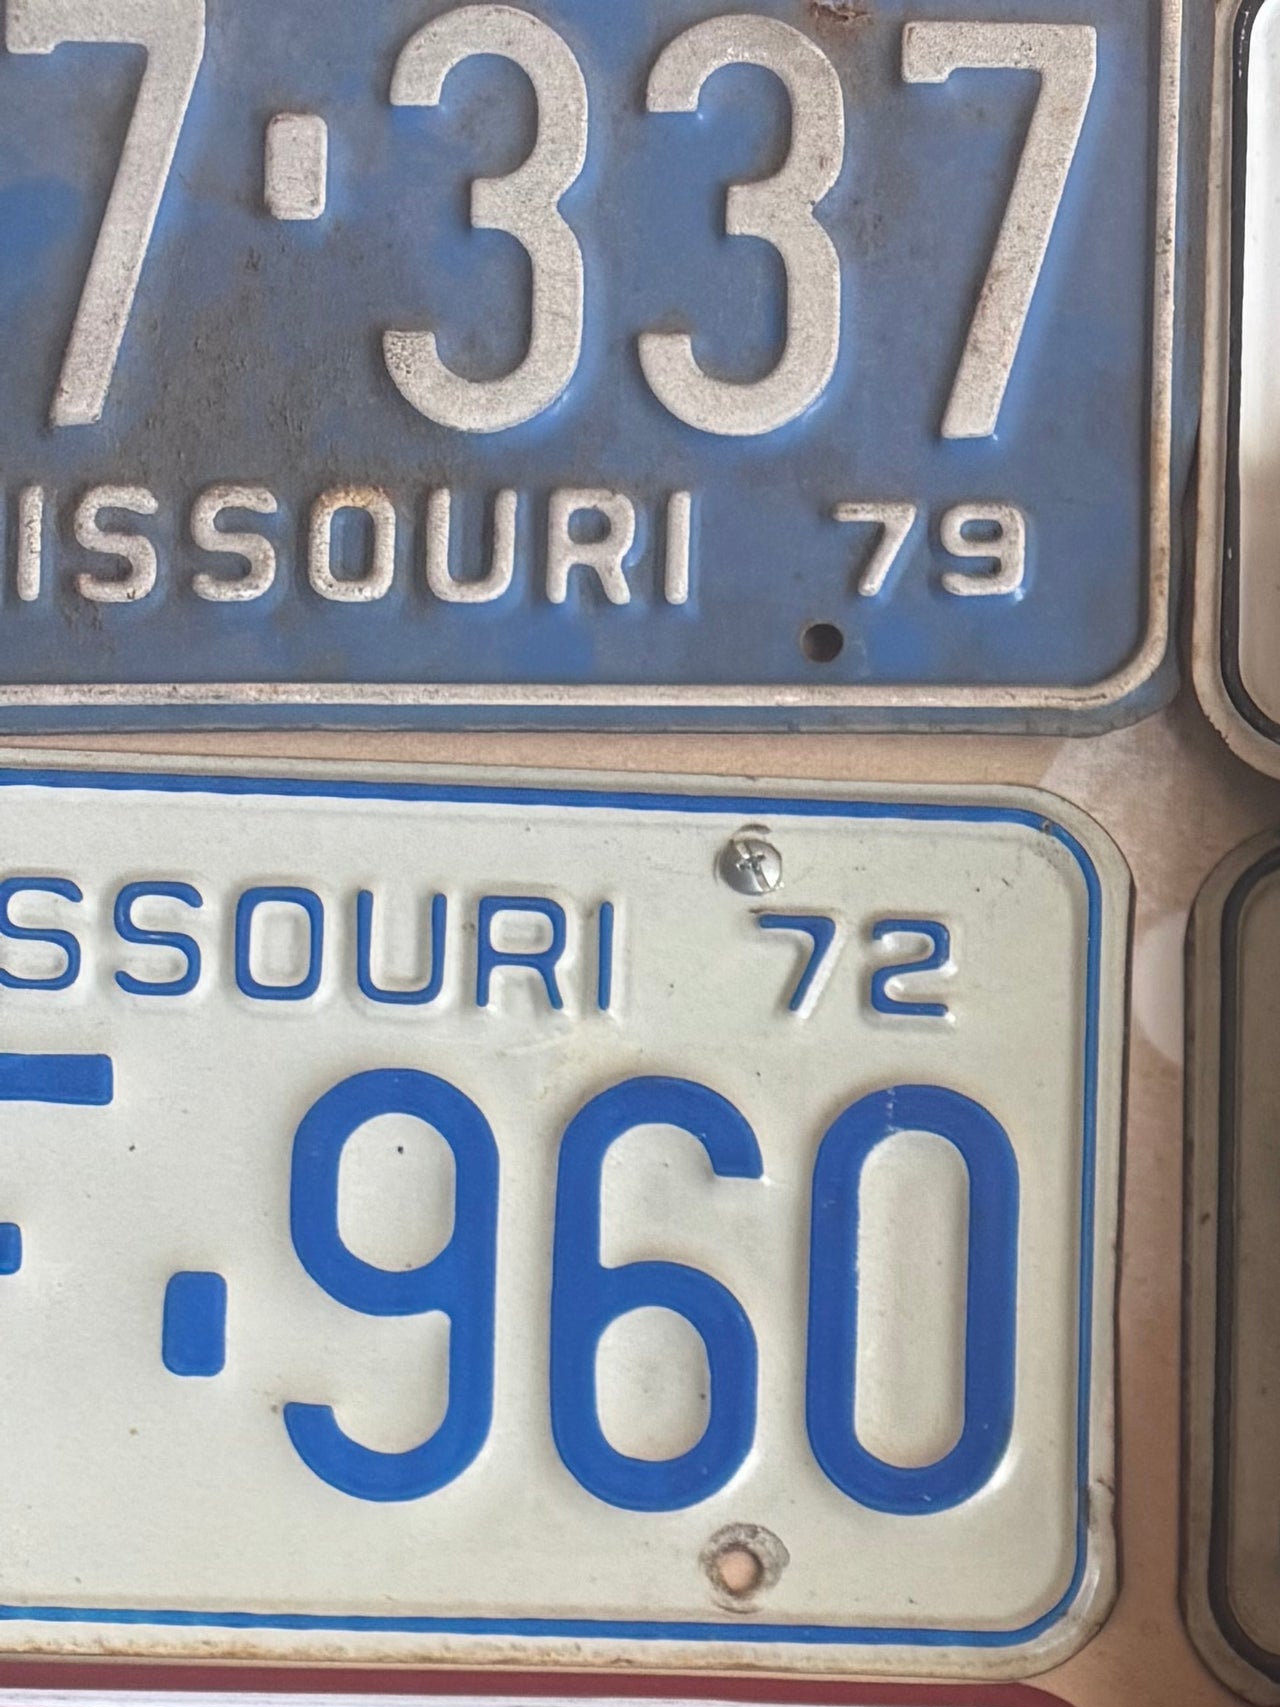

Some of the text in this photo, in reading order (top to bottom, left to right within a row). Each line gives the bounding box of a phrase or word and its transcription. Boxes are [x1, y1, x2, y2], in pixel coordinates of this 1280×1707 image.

[17, 484, 1029, 606] ISSOURI 79
[0, 876, 950, 1017] SSOURI 72
